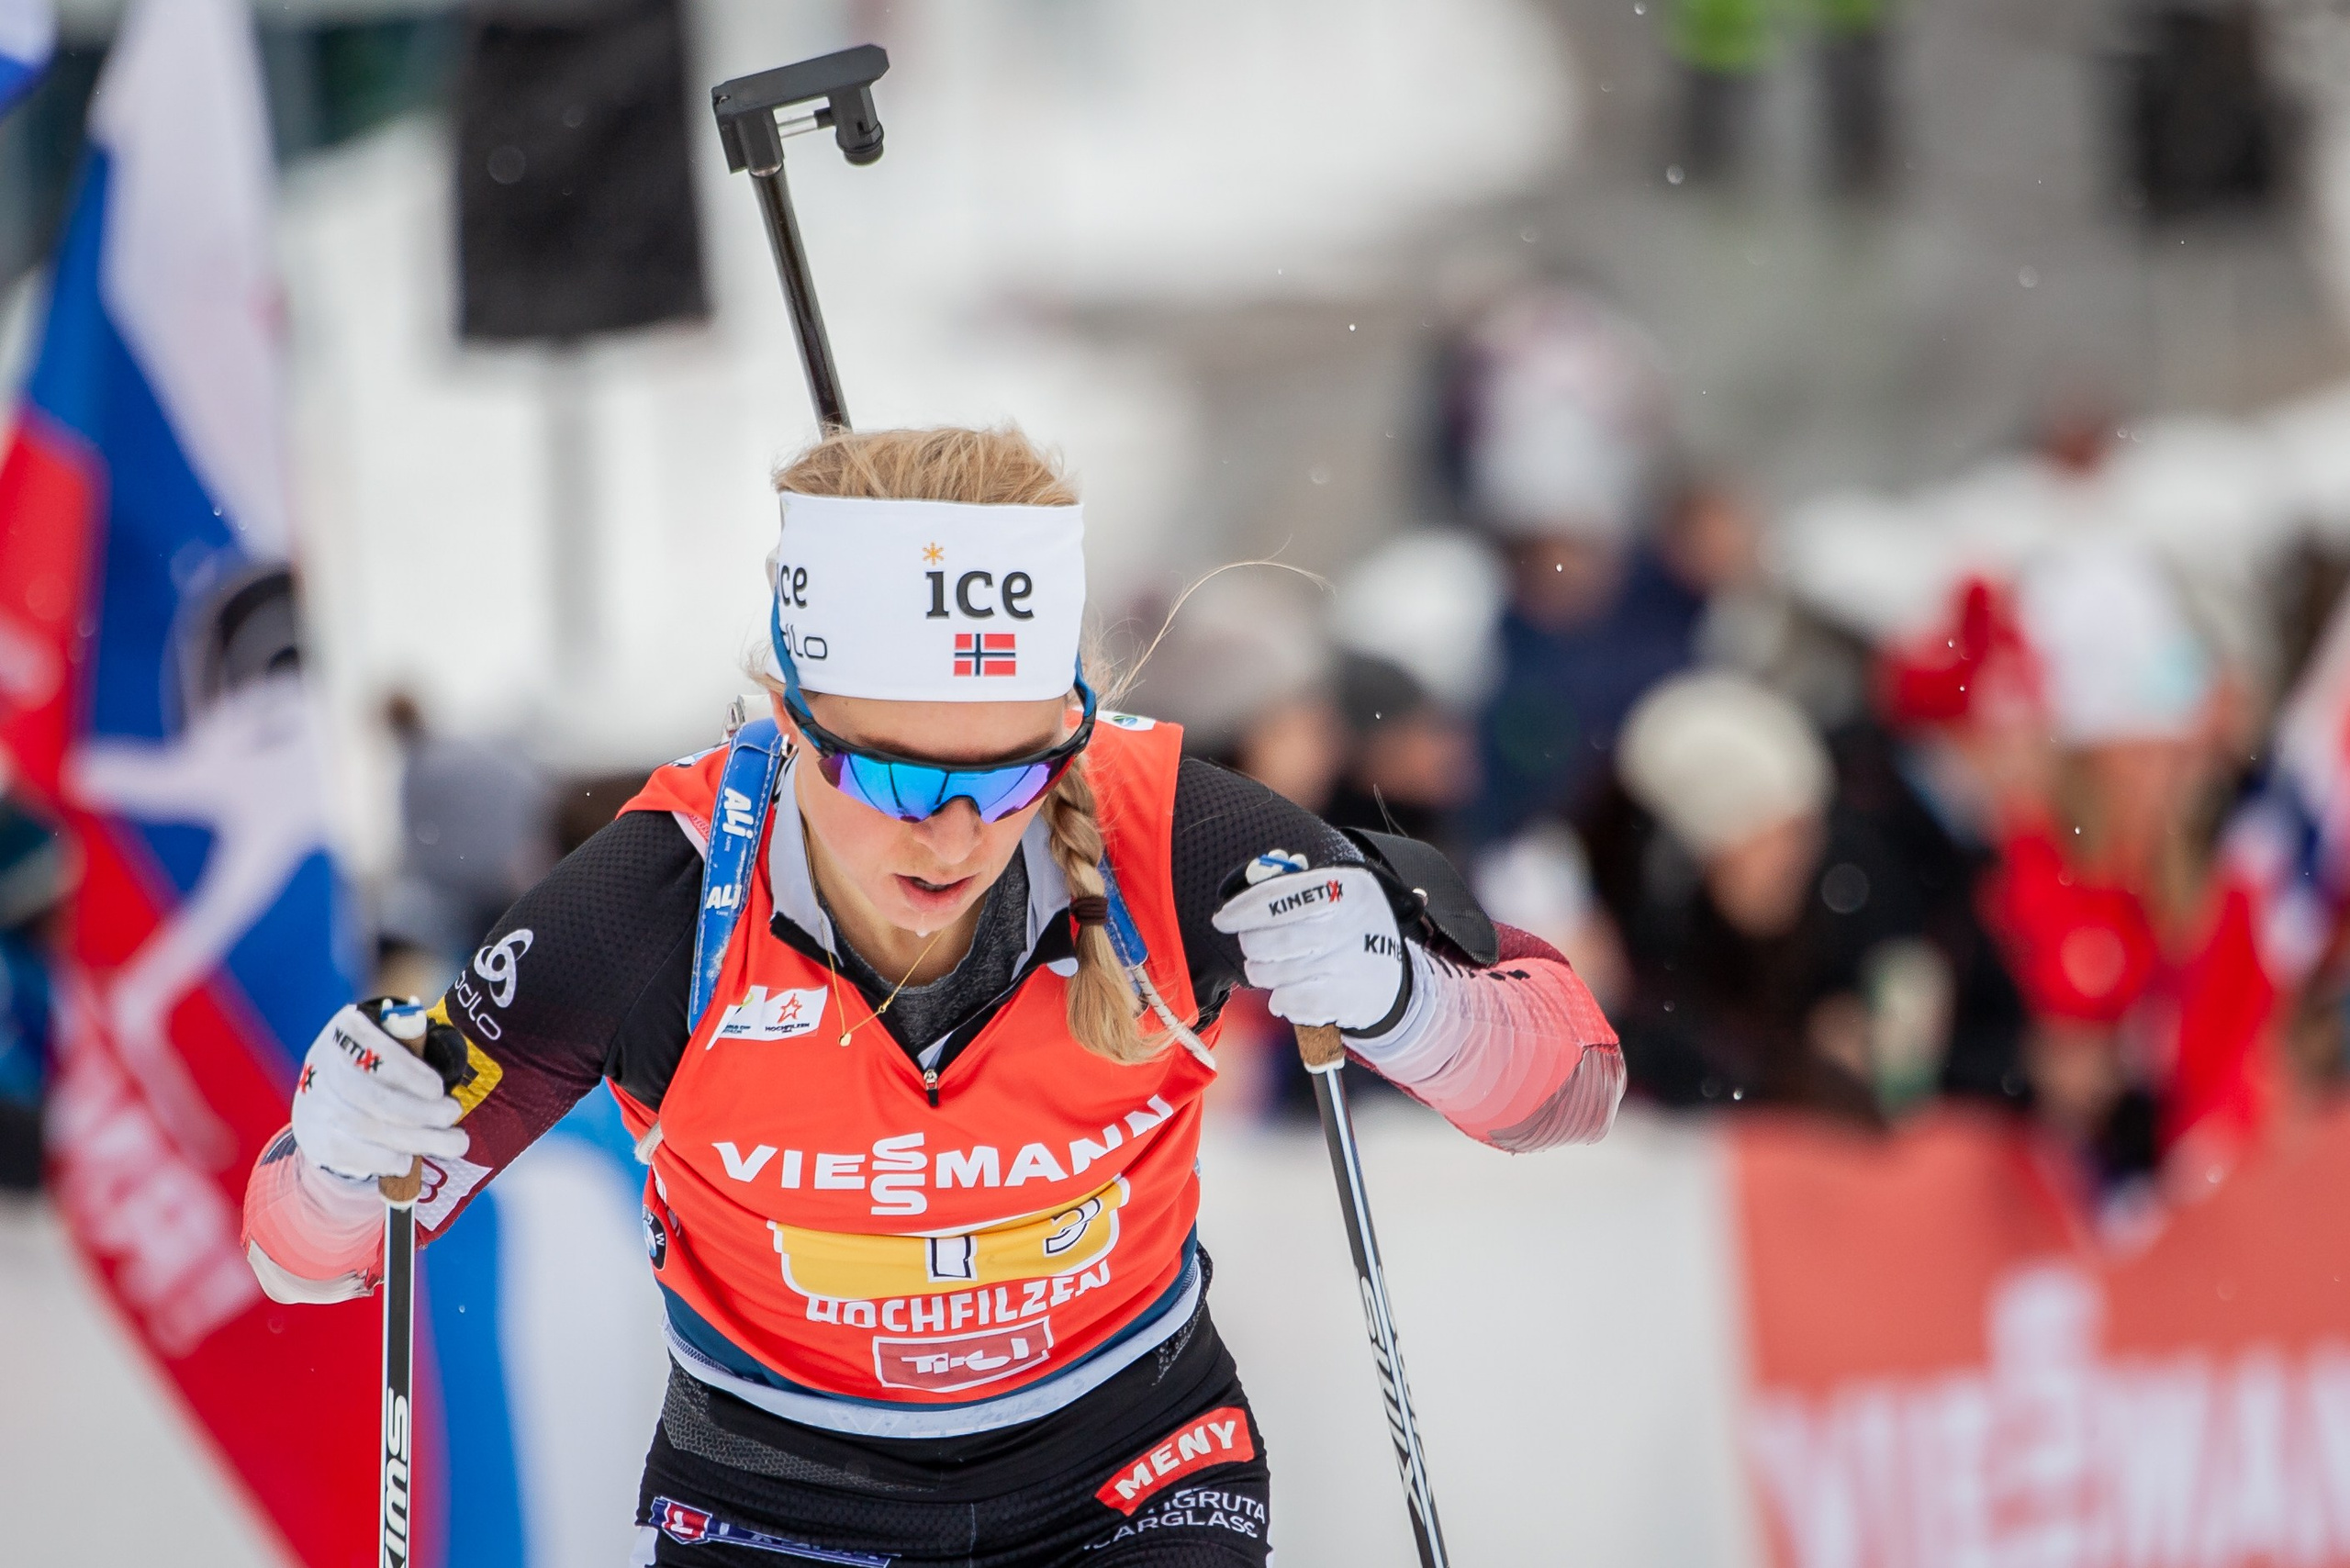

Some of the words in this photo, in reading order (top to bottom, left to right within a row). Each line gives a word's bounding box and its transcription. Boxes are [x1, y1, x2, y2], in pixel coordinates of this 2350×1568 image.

[777, 563, 808, 609] ce
[925, 543, 1035, 621] ice
[711, 1094, 1174, 1215] VIESSMANN
[806, 1260, 1110, 1333] HOCHFILZEN
[384, 1386, 408, 1568] SWI
[1113, 1420, 1237, 1500] MENY
